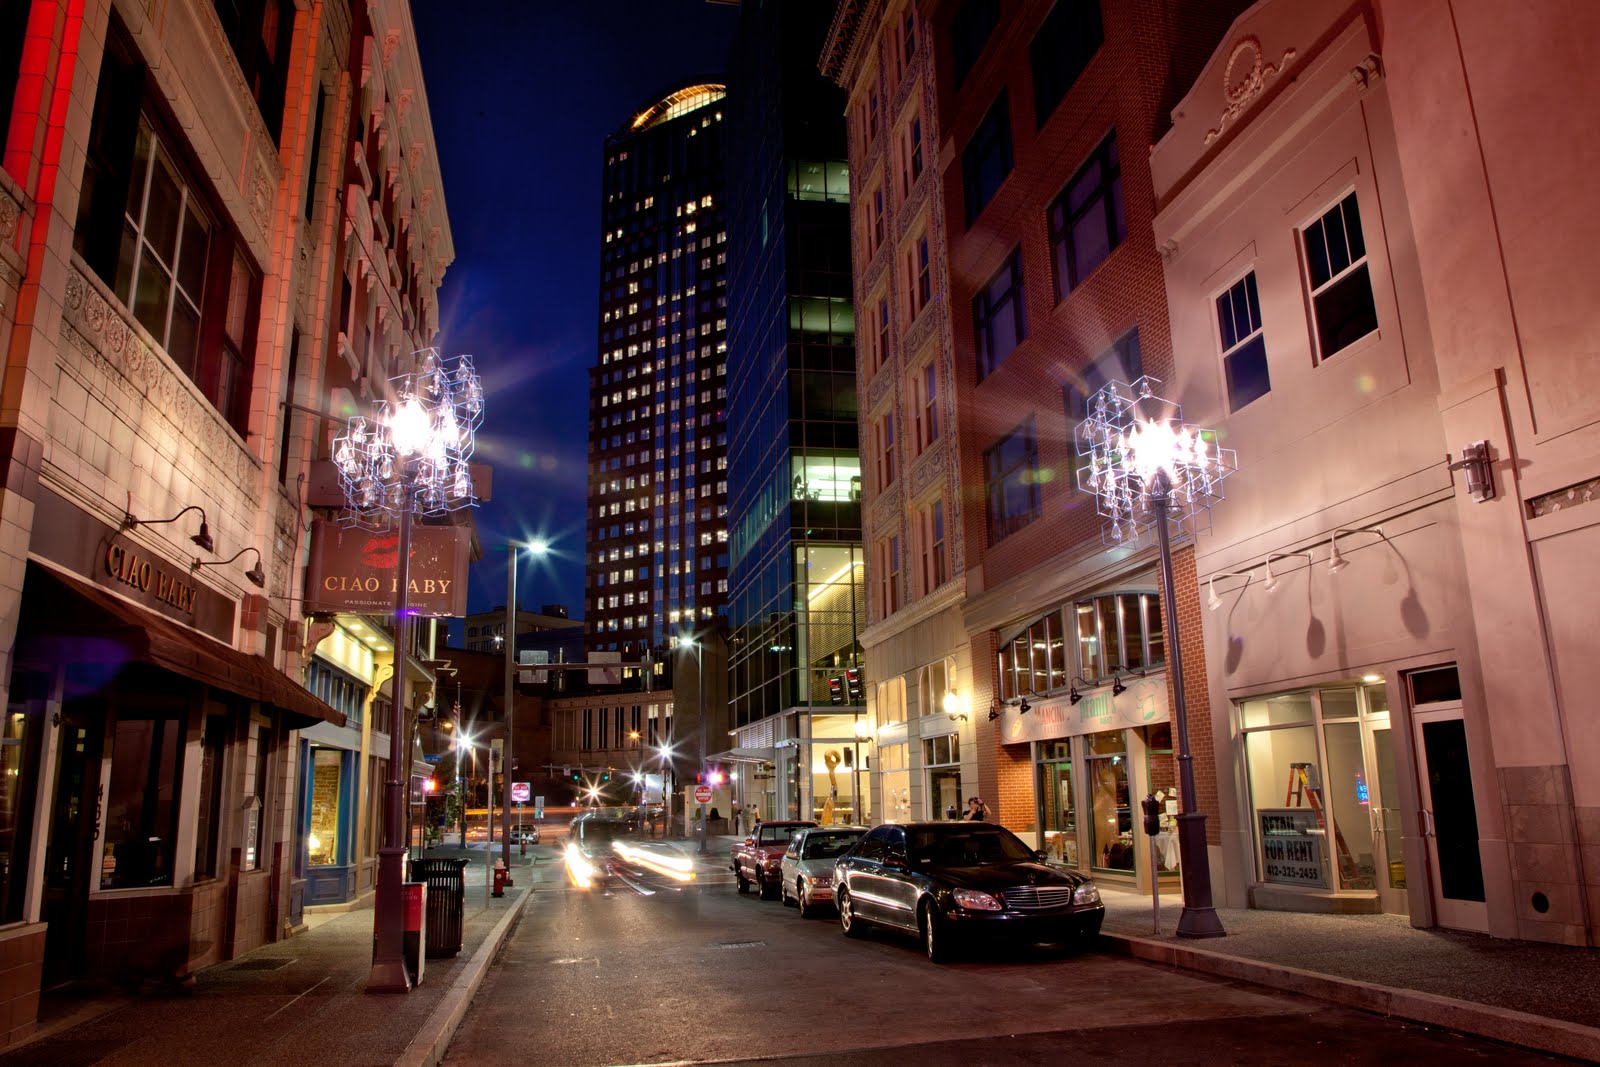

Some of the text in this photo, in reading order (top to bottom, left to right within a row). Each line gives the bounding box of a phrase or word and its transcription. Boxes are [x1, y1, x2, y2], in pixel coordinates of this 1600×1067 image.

[105, 543, 197, 616] CIAO BABY
[324, 576, 380, 592] CIAO
[1264, 839, 1313, 862] FOR RENT
[1267, 864, 1318, 880] 412-325-2455
